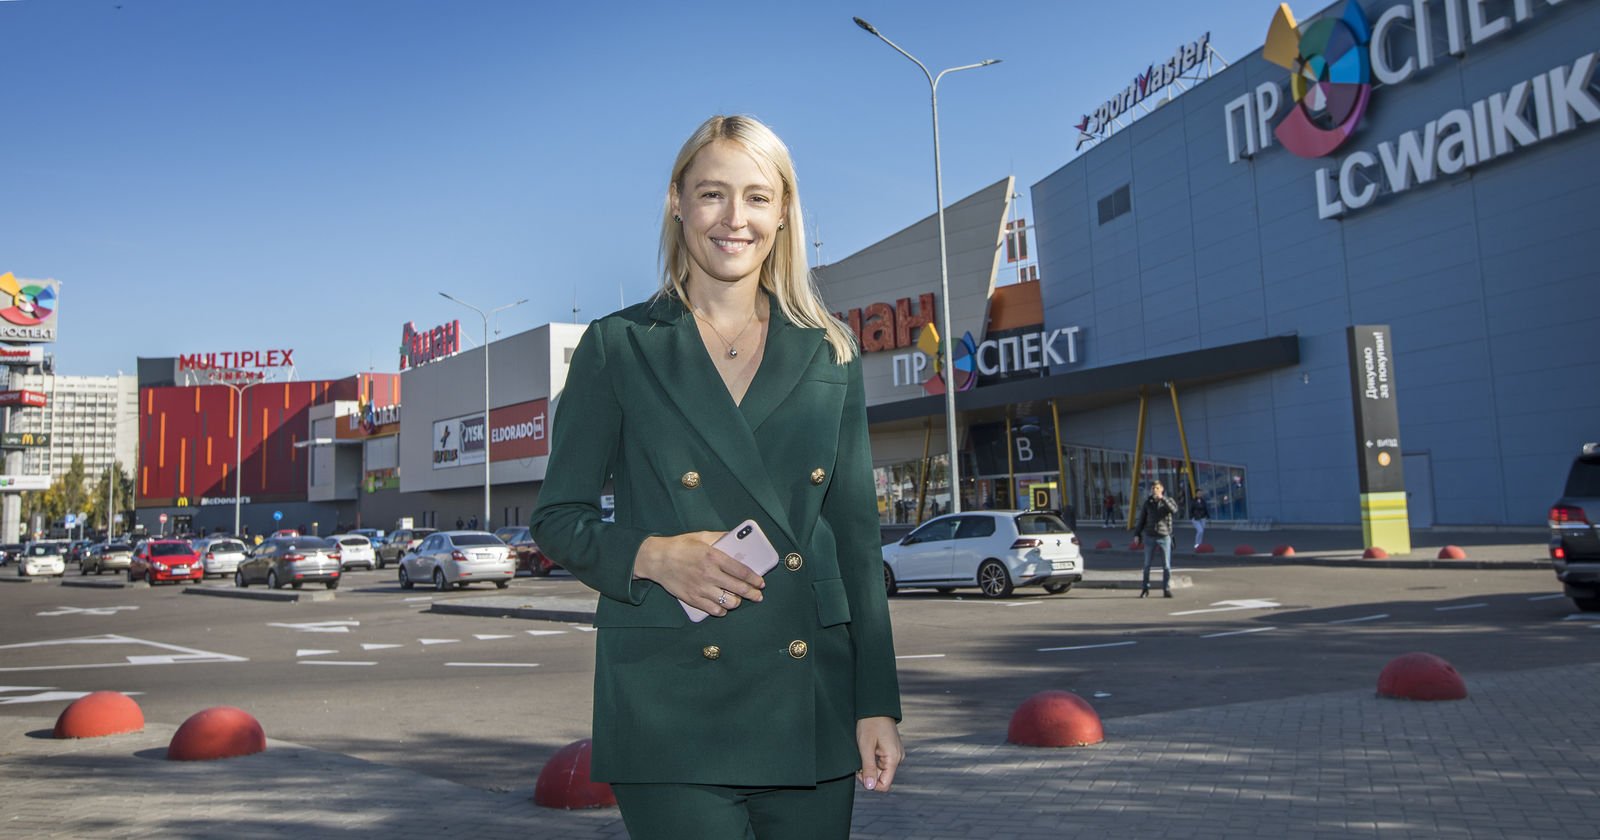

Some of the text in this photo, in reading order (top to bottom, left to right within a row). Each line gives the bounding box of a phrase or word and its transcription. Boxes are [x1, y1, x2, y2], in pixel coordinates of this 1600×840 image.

[0, 328, 54, 338] РОСПЕКТ
[178, 349, 294, 371] MULTIPLEX
[464, 424, 485, 443] JYSK
[491, 422, 533, 443] ELDORADO
[1016, 437, 1033, 461] B
[1036, 490, 1048, 507] D
